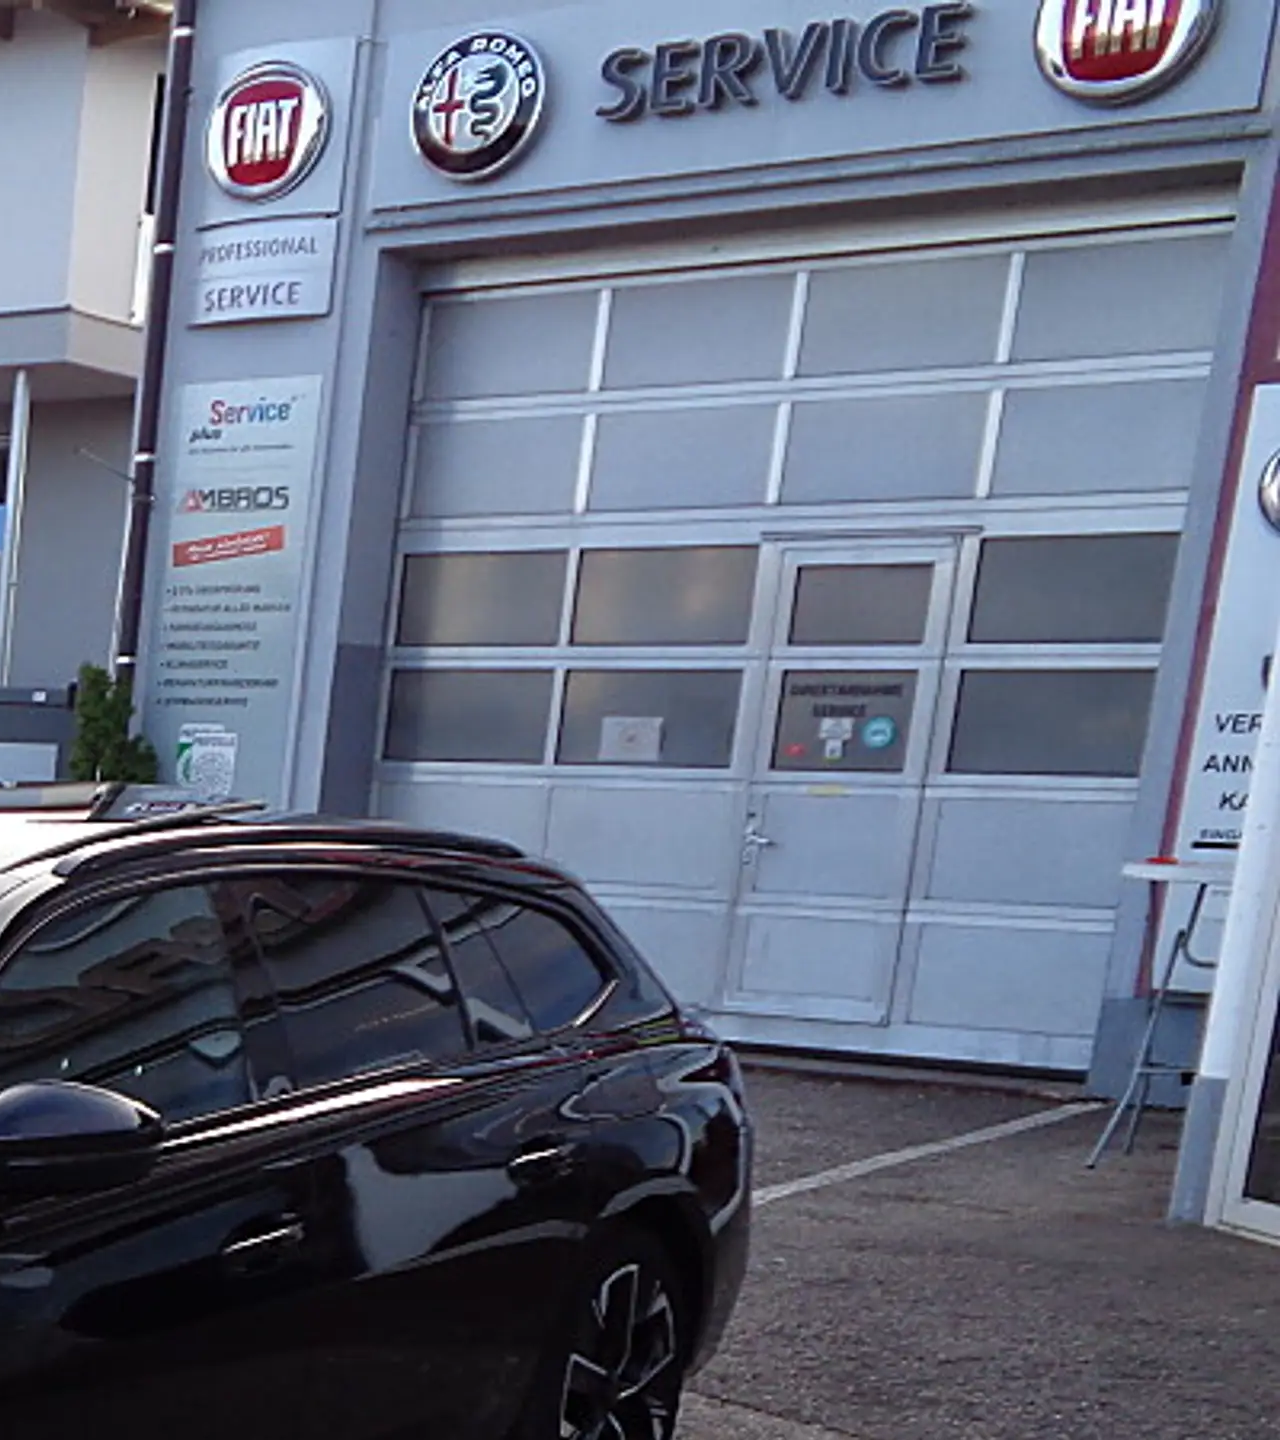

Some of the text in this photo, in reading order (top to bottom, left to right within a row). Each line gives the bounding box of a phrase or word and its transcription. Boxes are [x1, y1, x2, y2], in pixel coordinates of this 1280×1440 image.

[471, 38, 536, 97] ROMEO
[596, 2, 973, 122] SERVICE
[227, 97, 299, 167] FIAT
[199, 237, 319, 265] PROFESSIONAL
[205, 282, 302, 312] SERVICE
[210, 396, 291, 426] Service
